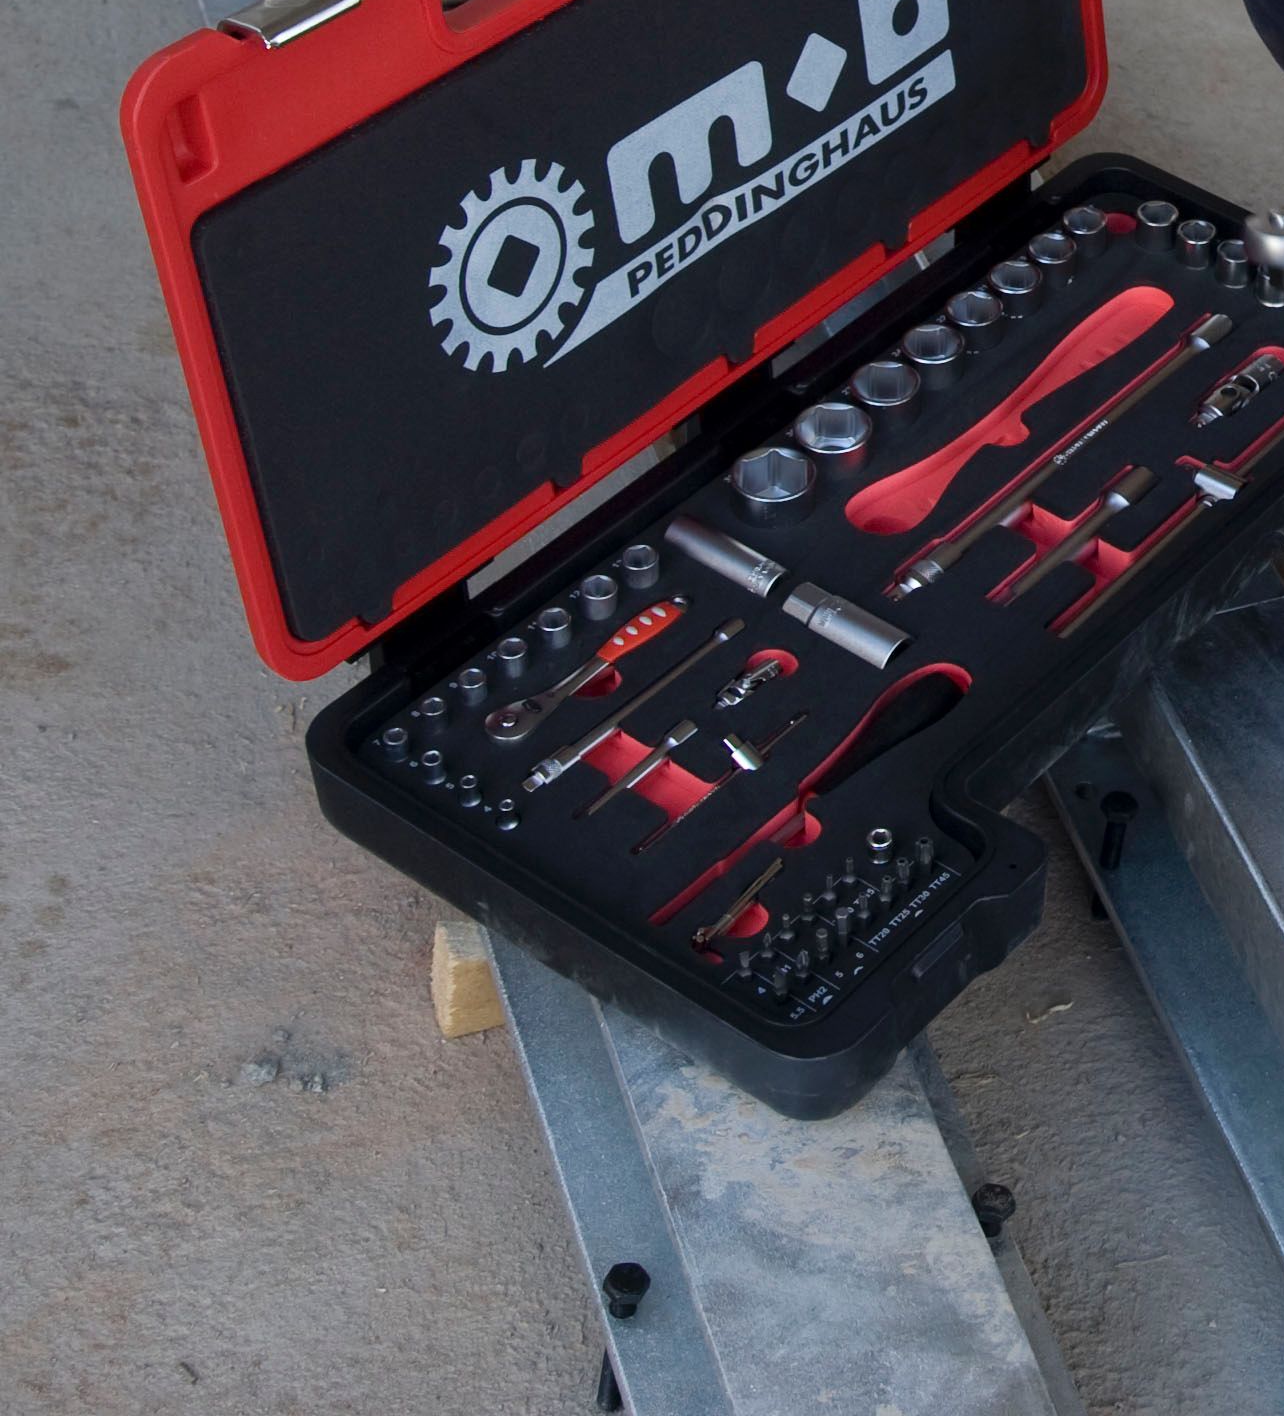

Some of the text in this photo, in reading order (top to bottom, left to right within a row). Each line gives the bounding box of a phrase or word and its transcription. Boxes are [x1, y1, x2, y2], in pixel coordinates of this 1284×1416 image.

[626, 77, 928, 298] PEDDINGHAUS
[807, 986, 829, 1004] PH2
[867, 927, 891, 947] TT20
[888, 908, 911, 928] TT25
[928, 871, 951, 891] TT45
